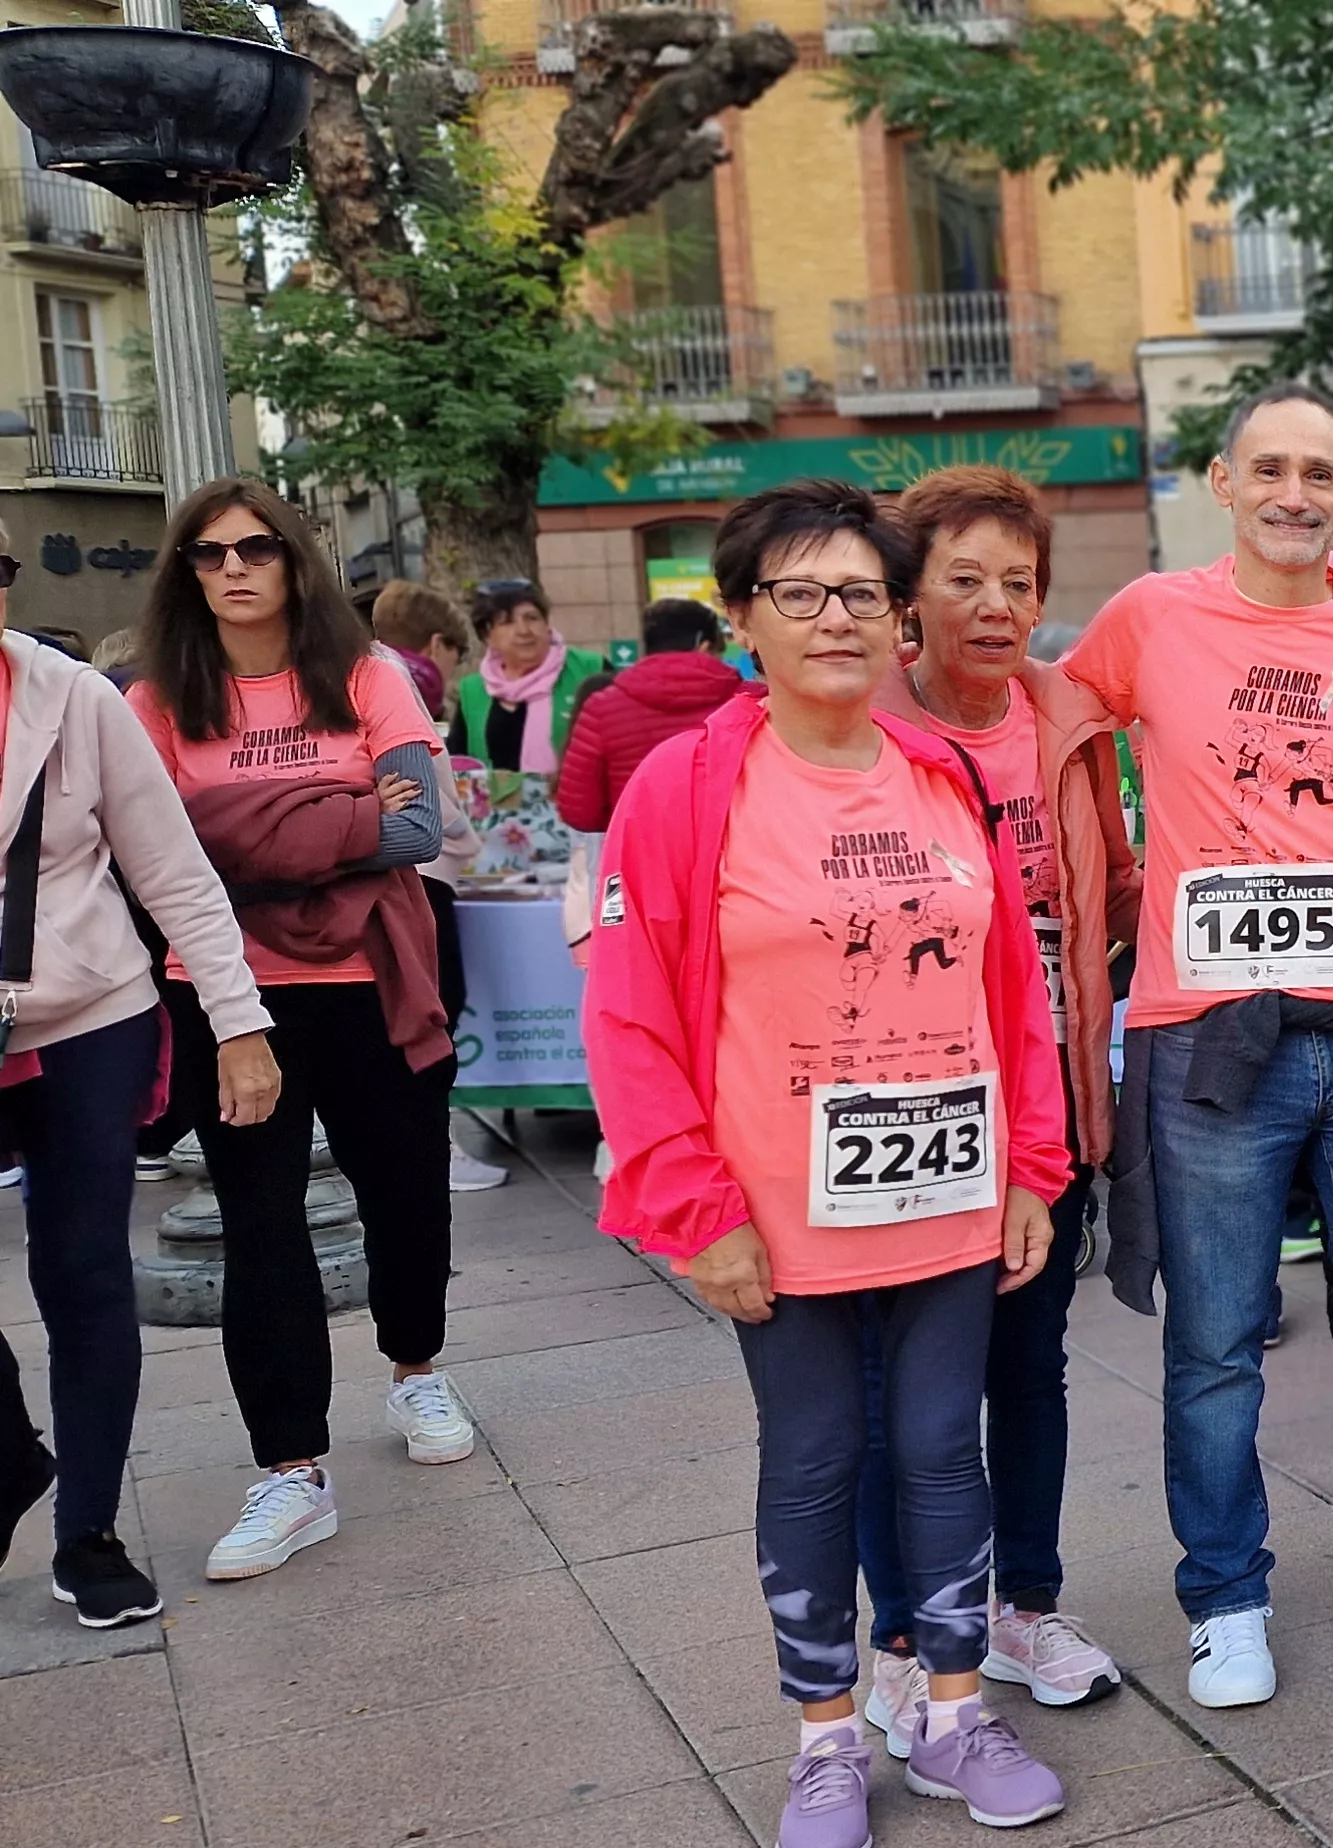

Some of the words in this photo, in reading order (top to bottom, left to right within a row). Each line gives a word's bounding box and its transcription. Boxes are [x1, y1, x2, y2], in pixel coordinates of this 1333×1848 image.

[1247, 666, 1322, 696] CORRAMOS
[1228, 688, 1258, 711] POR
[1258, 691, 1275, 714] LA
[242, 725, 307, 750] CORRAMOS
[229, 749, 254, 769] POR
[256, 748, 269, 766] LA
[273, 741, 319, 764] CIENCIA
[831, 831, 909, 858] CORRAMOS
[821, 857, 850, 880] POR
[852, 857, 870, 878] LA
[874, 851, 931, 877] CIENCIA
[1196, 890, 1256, 902] CONTRA
[1259, 889, 1274, 900] EL
[1244, 878, 1286, 888] HUESCA
[493, 1007, 575, 1021] asociación
[496, 1027, 565, 1044] española
[497, 1047, 547, 1062] contra
[838, 1111, 910, 1127] CONTRA
[913, 1110, 930, 1123] EL
[932, 1100, 980, 1120] CÁNCER
[898, 1097, 941, 1110] HUESCA
[833, 1122, 980, 1186] 2243
